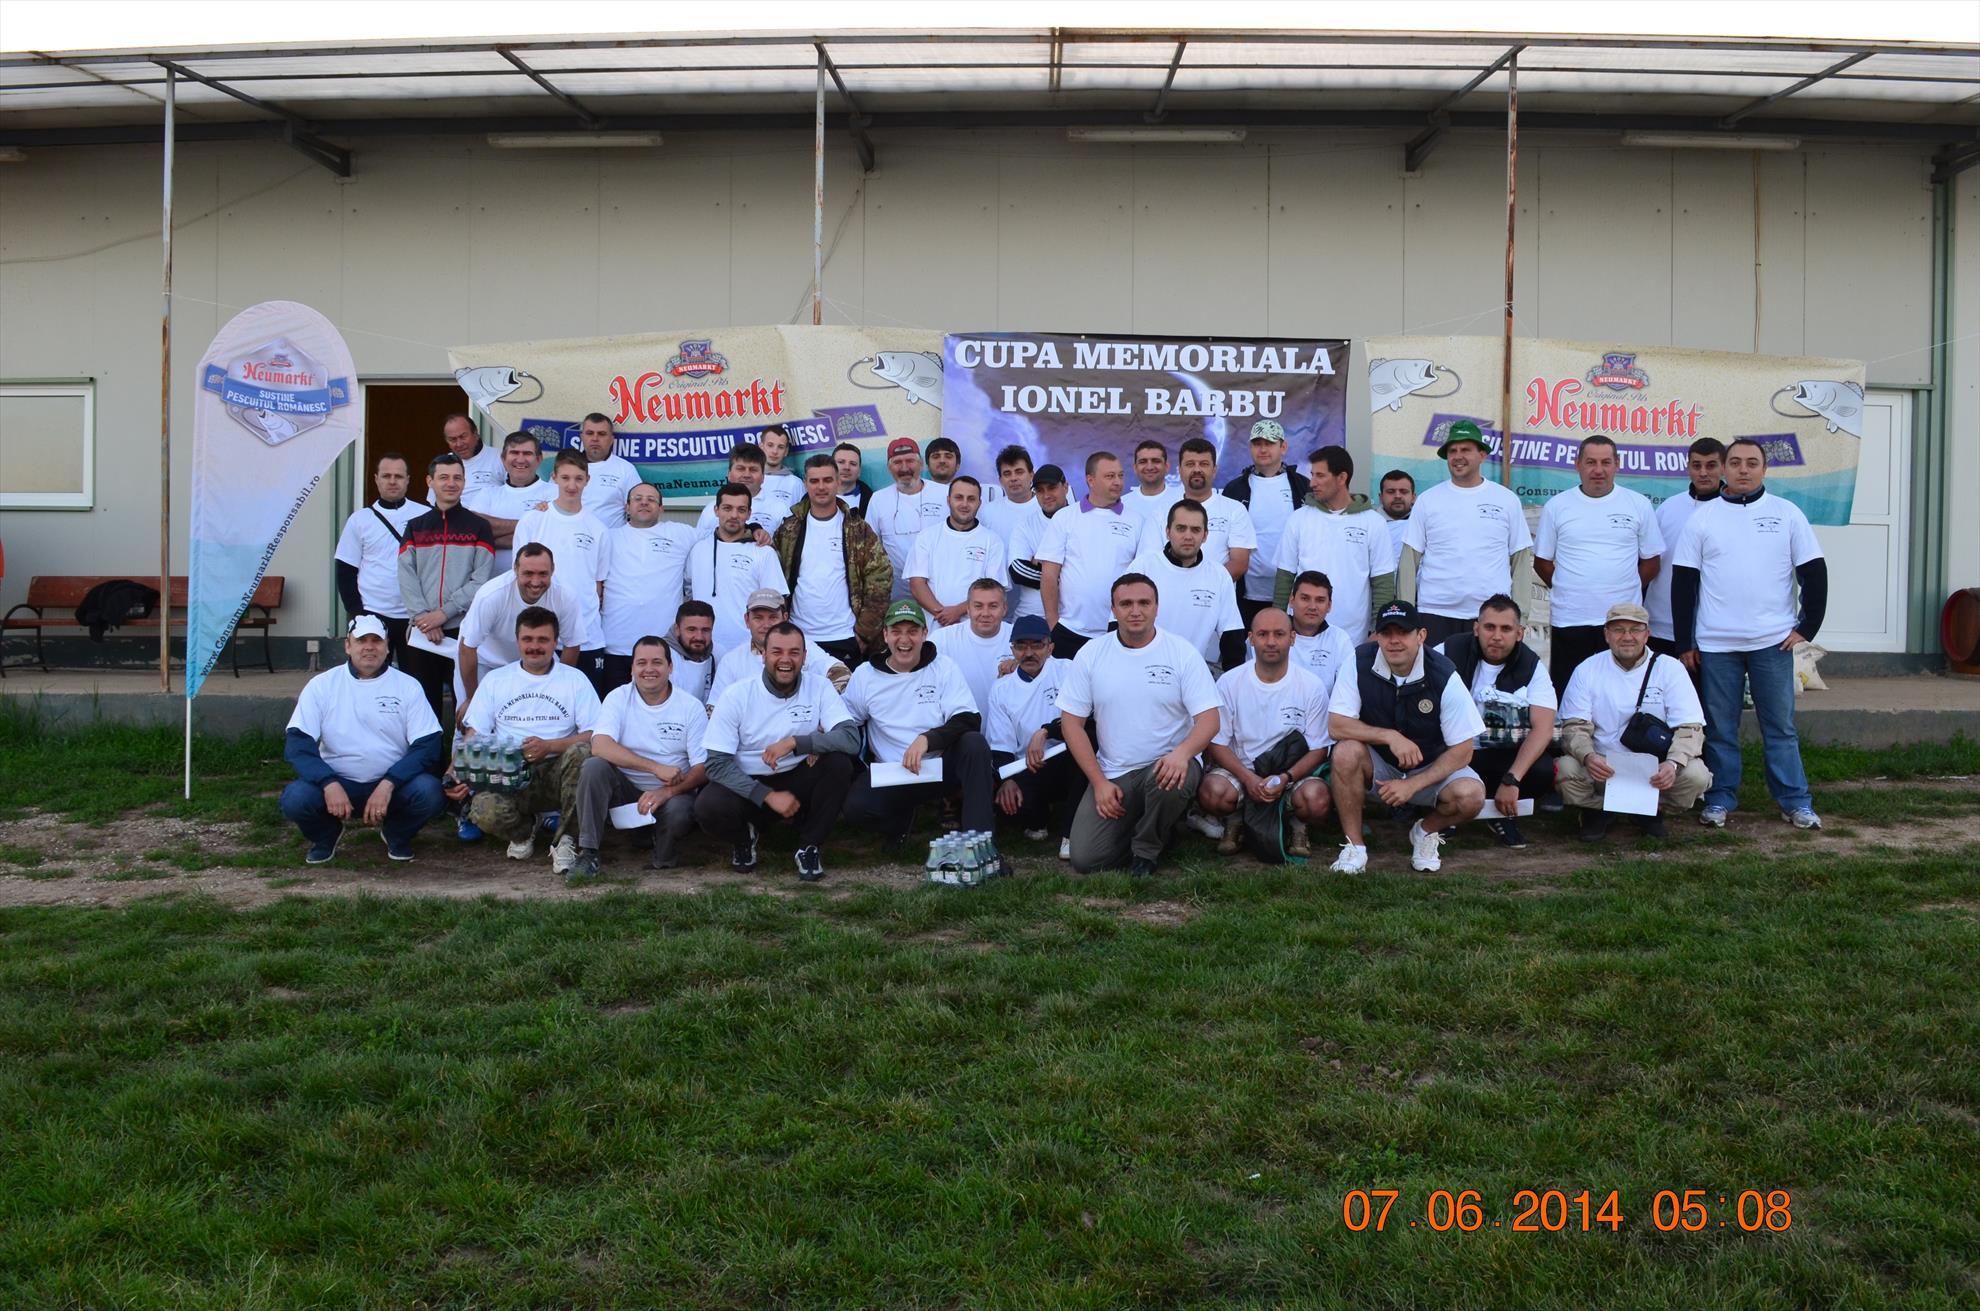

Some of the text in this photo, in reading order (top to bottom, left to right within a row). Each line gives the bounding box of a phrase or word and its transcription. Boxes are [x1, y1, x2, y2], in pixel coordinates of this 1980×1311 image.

[677, 363, 717, 373] NEUMARKT
[954, 340, 1335, 375] CUPA MEMORIALA
[242, 361, 314, 387] Neumarkt
[668, 379, 707, 390] Original
[1599, 376, 1638, 387] NEUMARKT
[226, 390, 327, 412] PESCUITUL ROMÂNESC
[608, 371, 785, 425] Neumarkt
[1001, 385, 1286, 418] IONEL BARBU
[1526, 377, 1703, 438] Neumarkt
[1554, 443, 1650, 471] PETUL
[200, 475, 321, 677] www.ConsumaNeumarktResponsabil.ro
